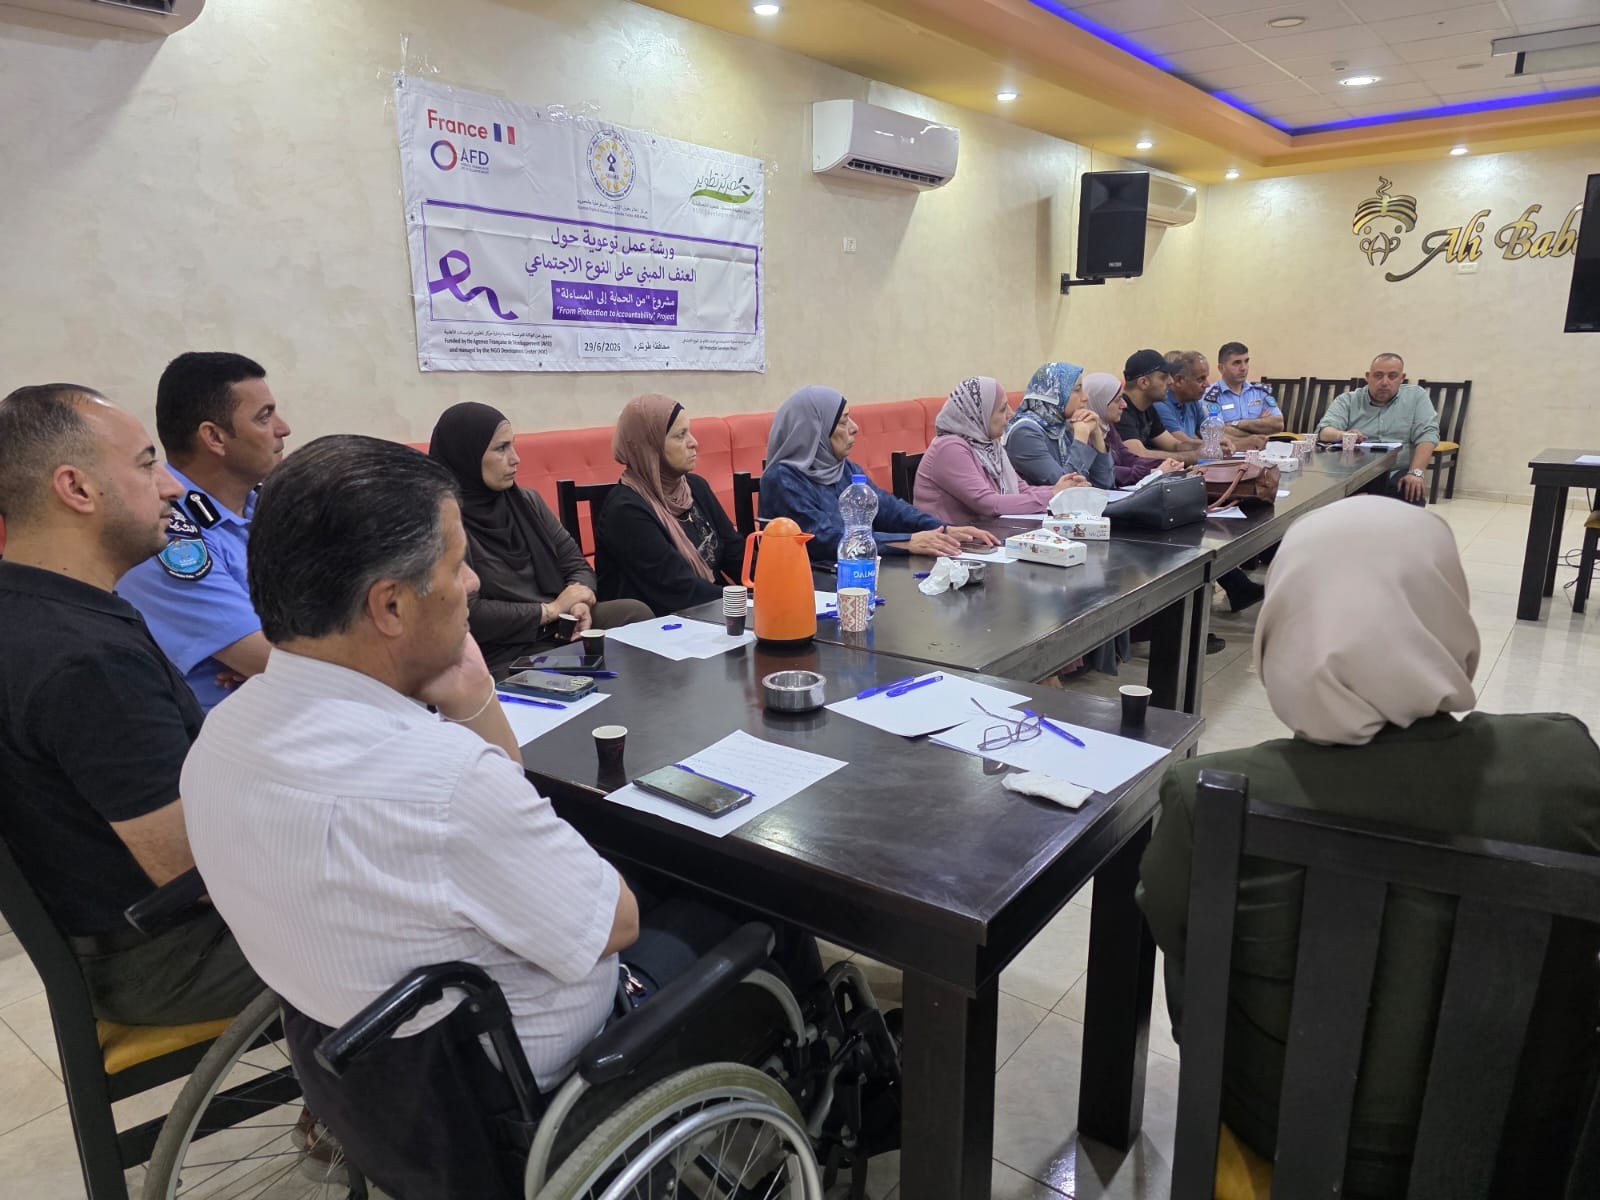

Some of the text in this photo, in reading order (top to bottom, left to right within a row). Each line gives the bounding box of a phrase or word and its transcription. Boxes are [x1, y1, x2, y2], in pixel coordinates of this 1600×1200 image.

[427, 109, 488, 139] France
[460, 148, 489, 165] AFD
[551, 226, 675, 259] ورشة عمل توعوية حول
[1385, 203, 1583, 282] Ali Bab
[525, 253, 697, 286] العنف المبني على النوع الاجتماعي
[577, 307, 608, 317] Protection
[609, 309, 616, 317] to
[657, 312, 675, 321] Project
